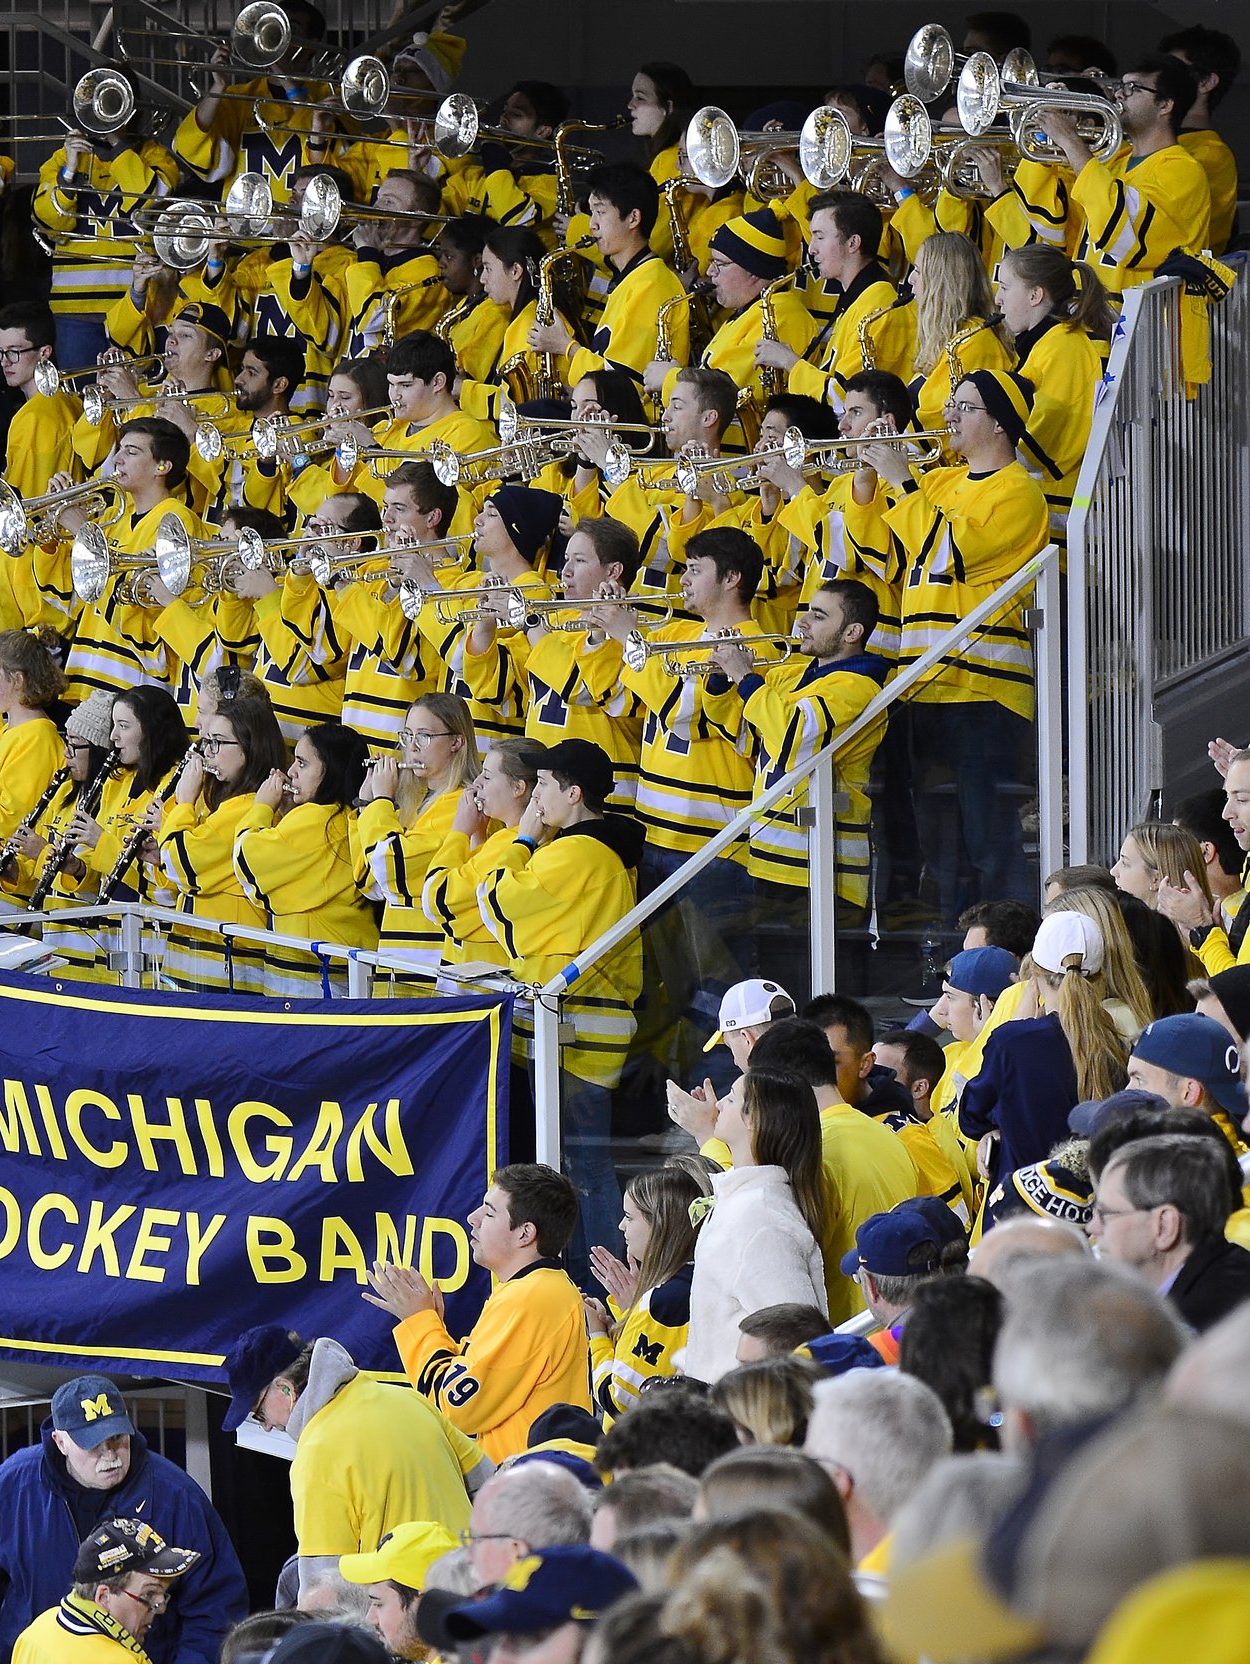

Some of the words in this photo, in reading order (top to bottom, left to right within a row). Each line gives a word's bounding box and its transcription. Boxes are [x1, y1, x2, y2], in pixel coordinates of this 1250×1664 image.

[246, 1211, 470, 1294] BAND
[631, 1332, 666, 1367] M
[442, 1363, 480, 1408] 19
[80, 1393, 113, 1422] M
